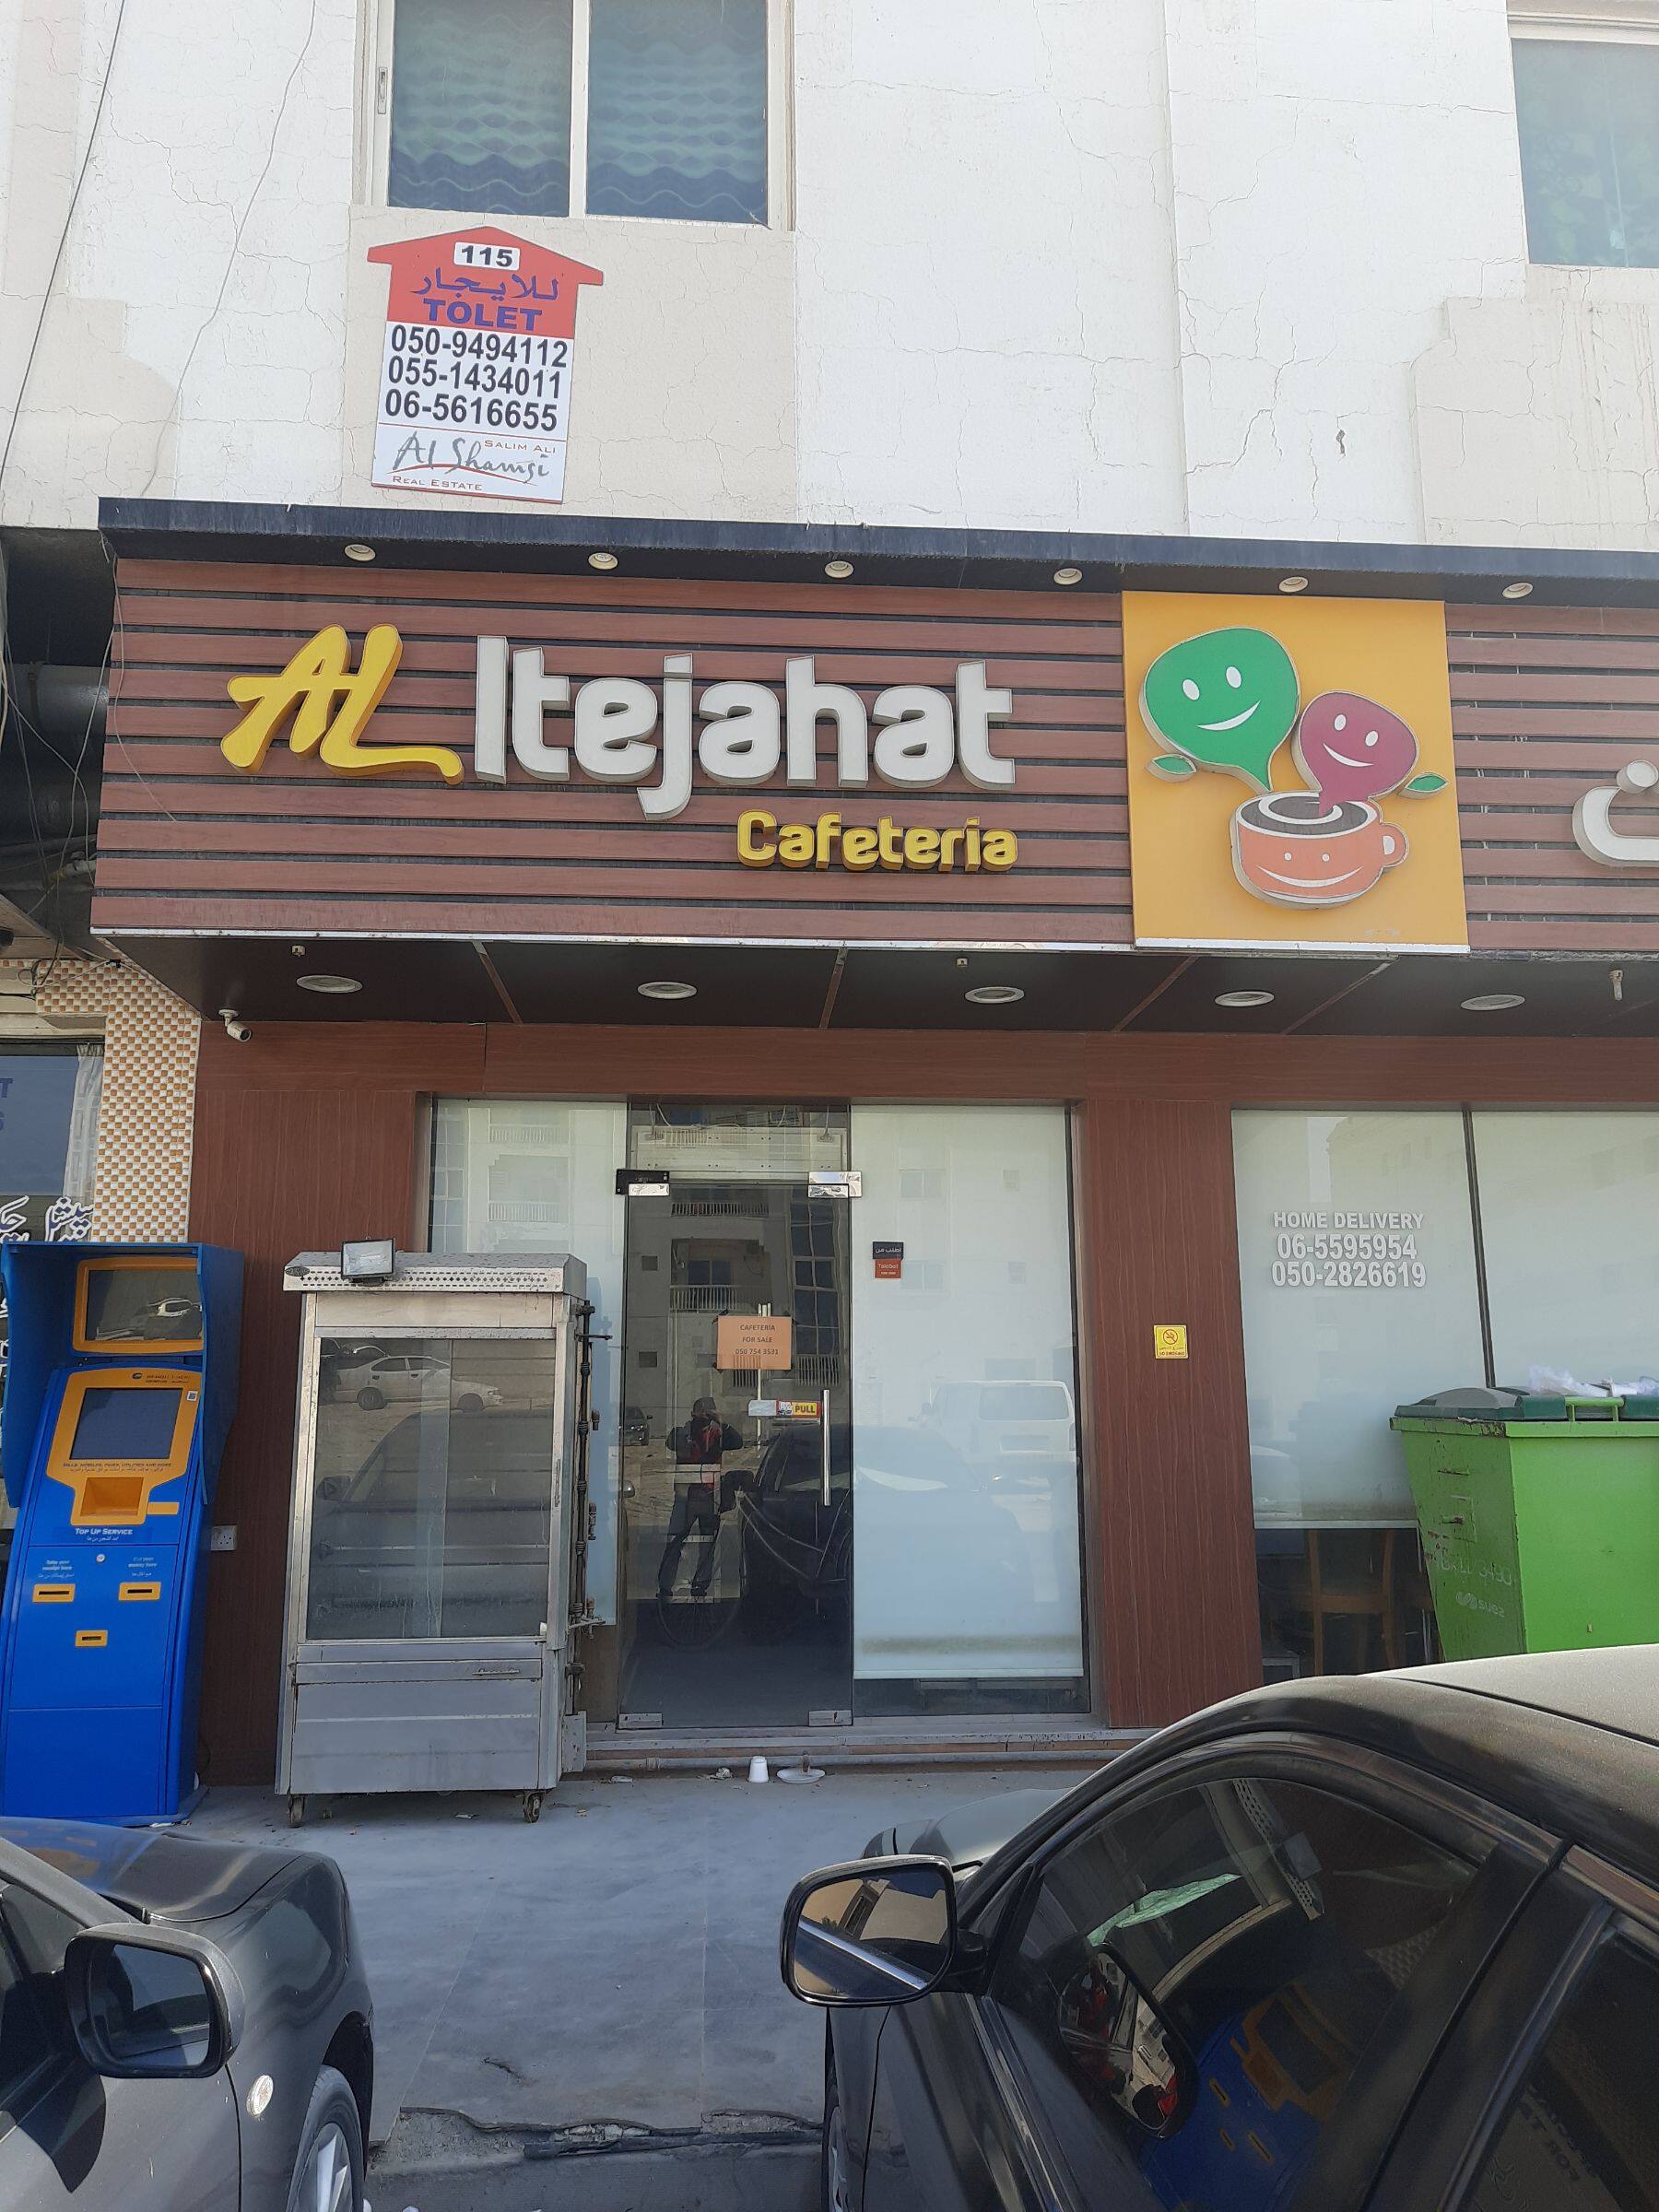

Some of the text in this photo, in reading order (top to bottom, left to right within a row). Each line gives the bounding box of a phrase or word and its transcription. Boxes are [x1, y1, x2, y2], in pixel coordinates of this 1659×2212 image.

[461, 245, 513, 267] 115
[409, 267, 559, 301] للايجار
[423, 298, 542, 331] TOLET
[391, 324, 568, 368] 050-9494112
[388, 355, 560, 399] 055-1434011
[385, 388, 558, 431] 06-5616655
[485, 440, 556, 453] SALIM ALI
[430, 478, 483, 491] ESTATE
[736, 809, 1018, 873] Cafeteria
[1273, 1211, 1424, 1230] HOME DELIVERY
[1277, 1233, 1418, 1260] 06-5595954
[1271, 1260, 1427, 1288] 050-2826619
[794, 1405, 816, 1413] PULL
